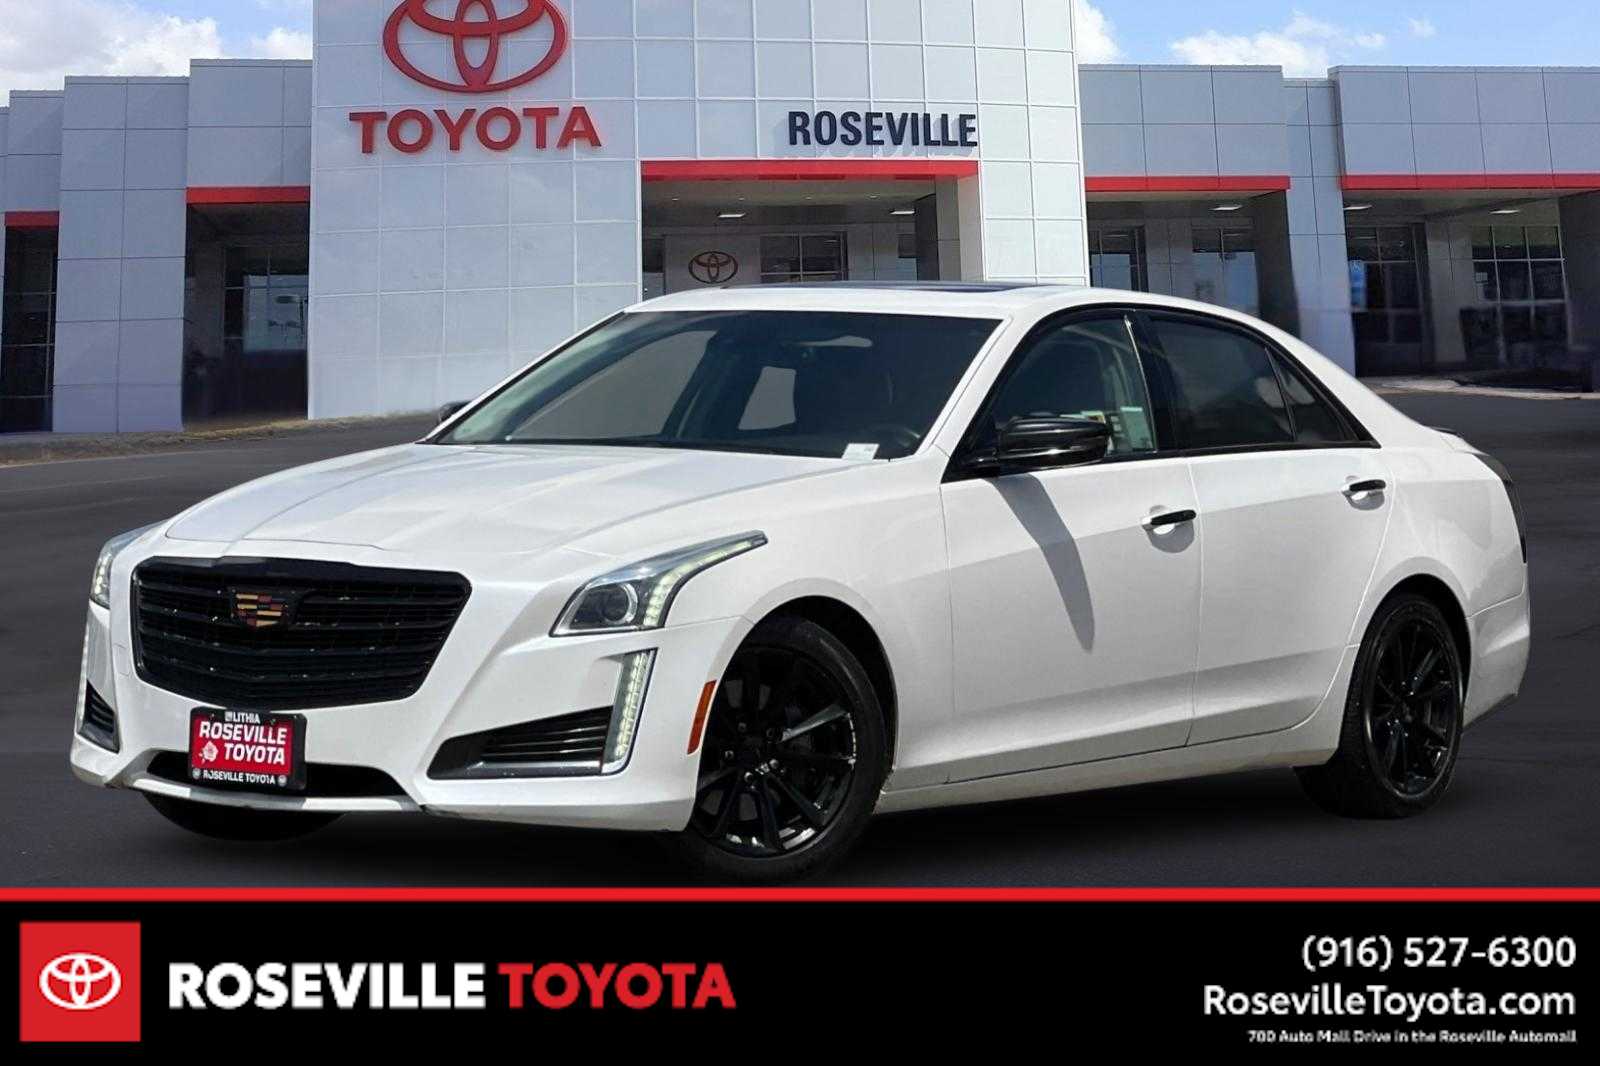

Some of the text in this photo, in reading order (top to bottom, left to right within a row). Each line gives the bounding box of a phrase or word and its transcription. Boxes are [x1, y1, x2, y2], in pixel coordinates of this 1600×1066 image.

[349, 106, 602, 154] TOYOTA
[788, 110, 978, 147] ROSEVILLE
[232, 711, 261, 724] LITHIA
[199, 721, 287, 745] ROSEVILLE
[223, 743, 285, 765] TOYOTA
[246, 774, 276, 785] TOYOTA
